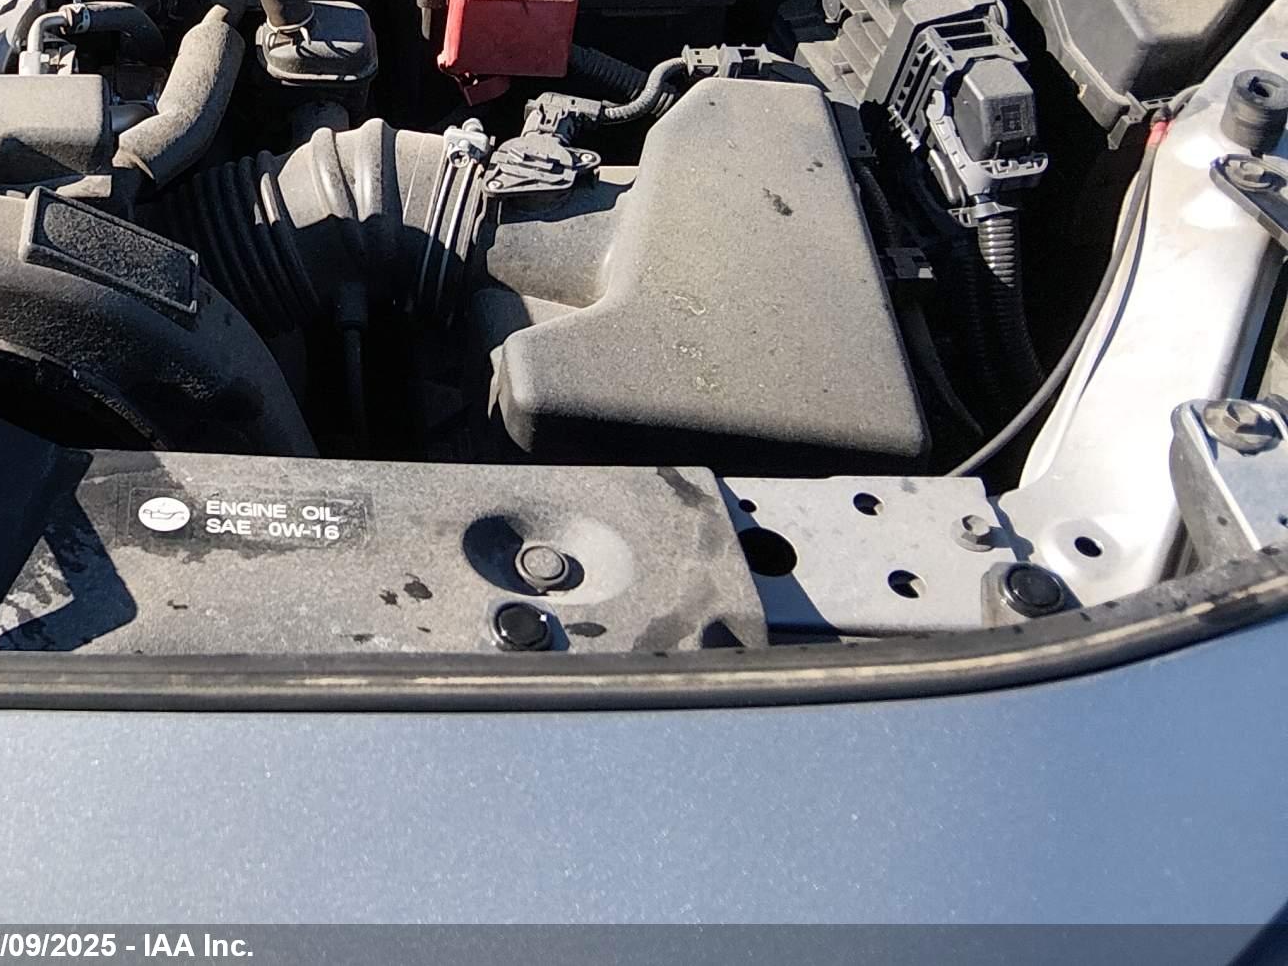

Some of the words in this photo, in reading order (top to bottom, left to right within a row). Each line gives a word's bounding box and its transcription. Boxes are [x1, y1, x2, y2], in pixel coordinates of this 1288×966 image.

[205, 500, 287, 519] ENGINE
[301, 505, 340, 522] OIL
[205, 518, 251, 535] SAE
[268, 521, 340, 540] 0W-16
